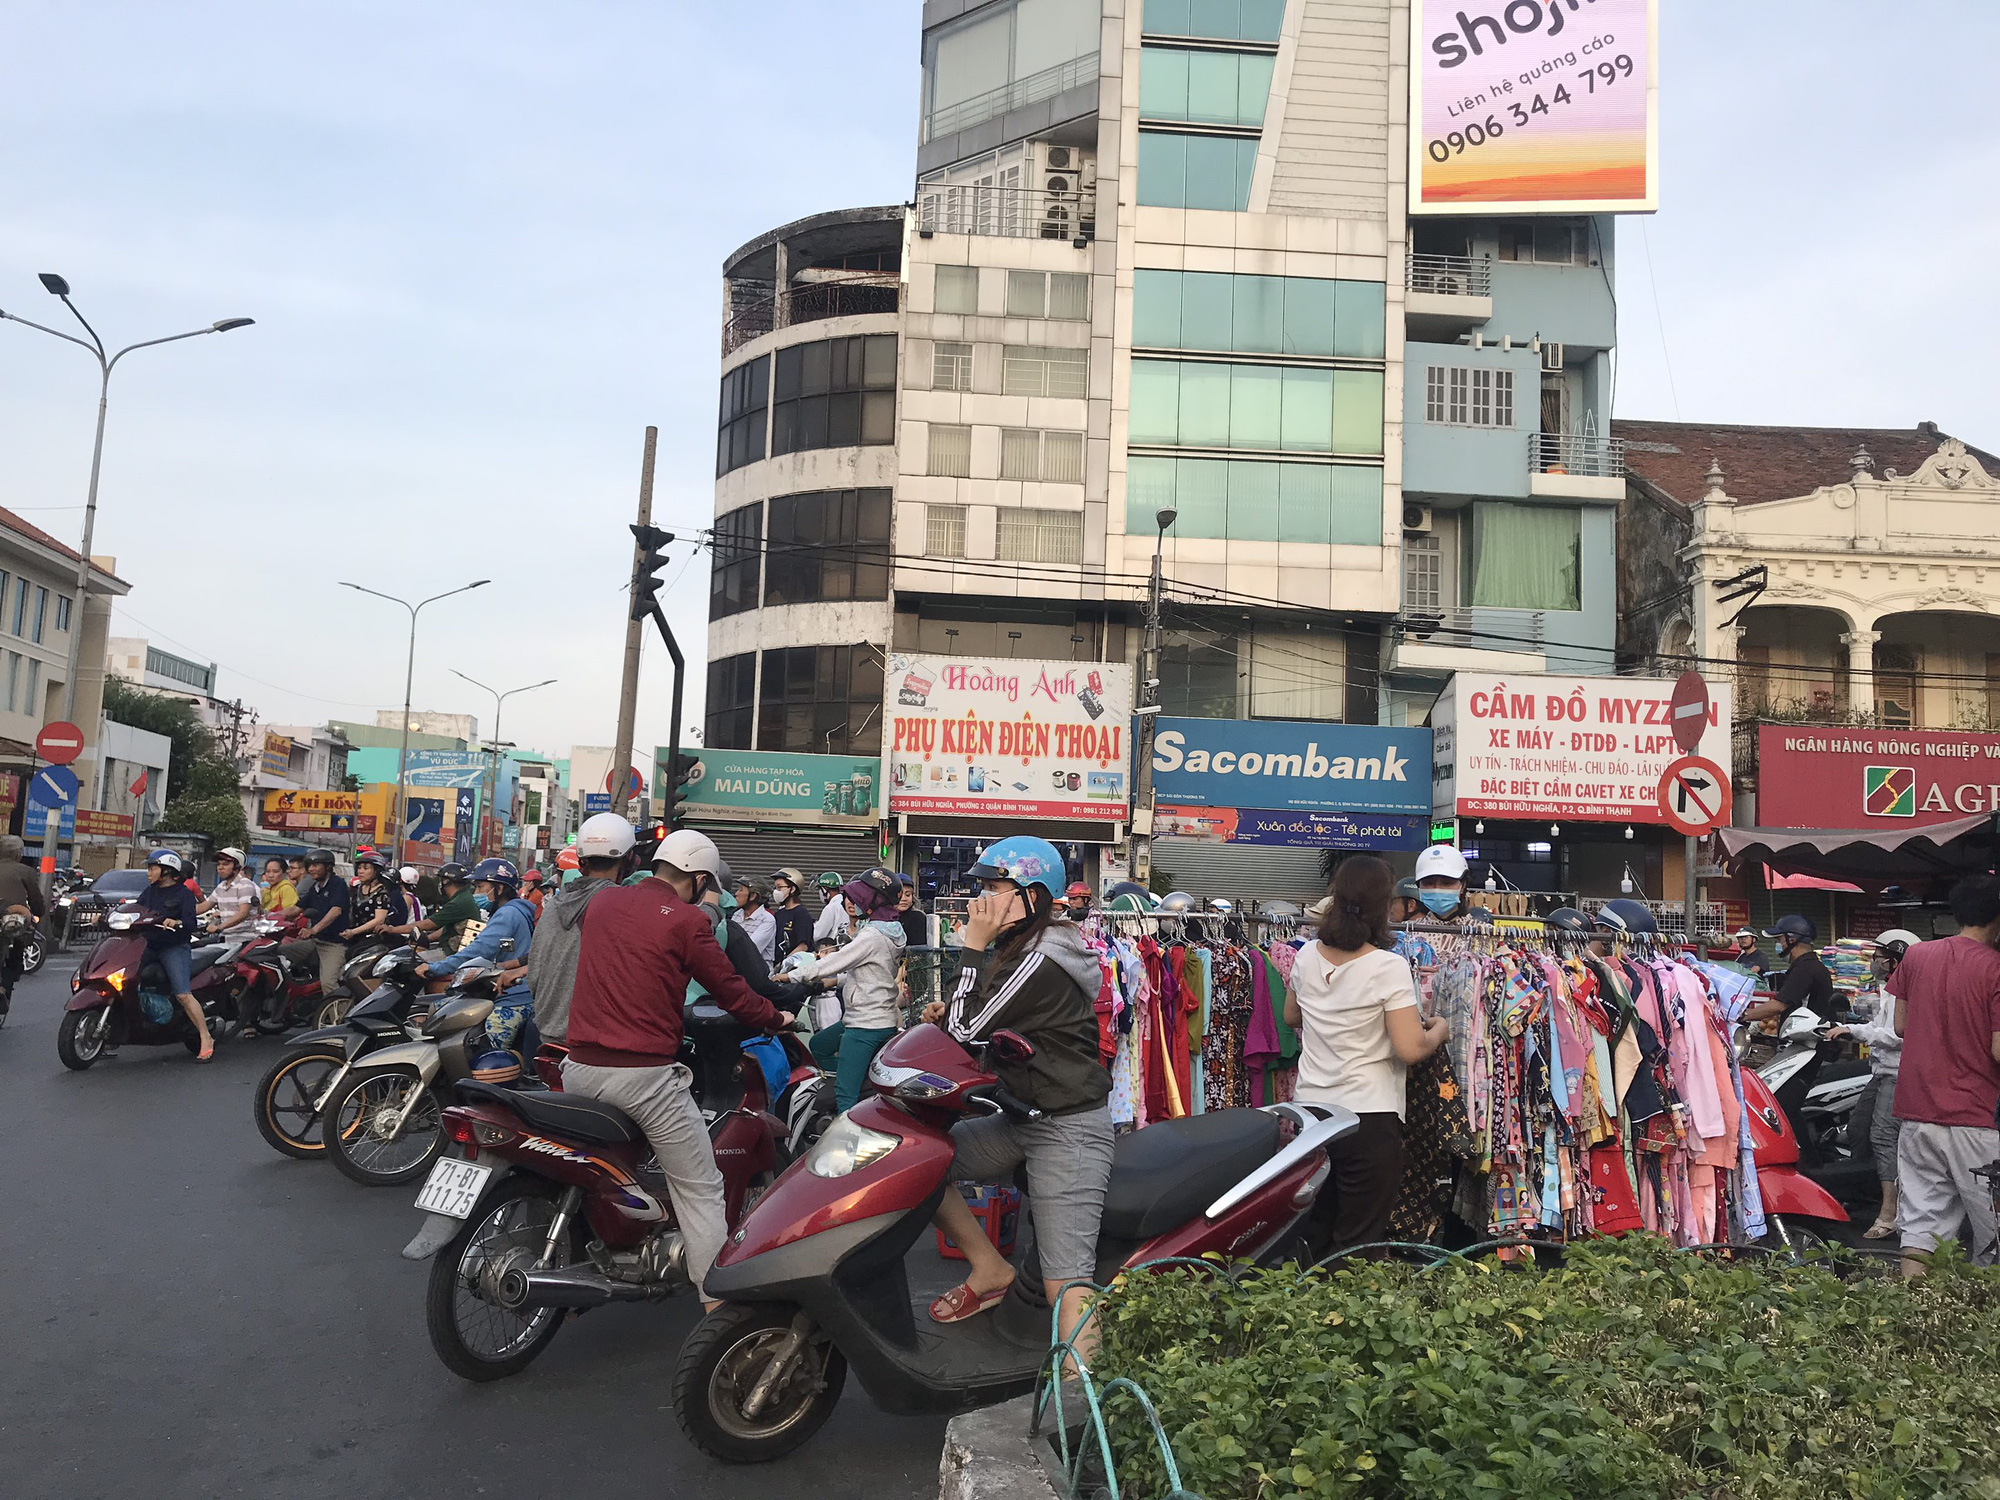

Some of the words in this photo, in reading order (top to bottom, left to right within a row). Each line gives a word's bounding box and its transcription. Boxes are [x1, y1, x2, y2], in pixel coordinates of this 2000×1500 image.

[1432, 0, 1597, 68] shoj
[1447, 93, 1487, 117] Liên
[1490, 77, 1513, 98] hệ
[1519, 51, 1578, 86] quảng
[1582, 34, 1615, 55] cáo
[1428, 114, 1504, 163] 0906
[1507, 83, 1571, 127] 344
[1578, 54, 1634, 94] 799
[941, 664, 1019, 702] Hoàng
[1031, 663, 1078, 704] Anh
[1469, 682, 1535, 720] CẦM
[1546, 685, 1587, 722] ĐỒ
[1599, 697, 1718, 727] MYZZN
[893, 717, 936, 762] PHỤ
[941, 708, 994, 765] KIỆN
[998, 711, 1050, 767] ĐIỆN
[1055, 723, 1122, 769] THOẠI
[1489, 728, 1510, 748] XE
[1517, 726, 1554, 750] MÁY
[1571, 732, 1617, 752] ĐTDĐ
[1785, 735, 1828, 752] NGÂN
[1831, 737, 1873, 754] HÀNG
[1878, 739, 1920, 756] NÔNG
[1925, 741, 1980, 761] NGHIỆP
[1153, 730, 1410, 782] Sacombank
[1470, 756, 1482, 769] UY
[1485, 753, 1501, 770] TÍN
[1510, 754, 1541, 772] TRÁCH
[1544, 756, 1577, 776] NHIỆM
[1585, 761, 1605, 775] CHU
[1608, 758, 1629, 776] ĐÁO
[1637, 760, 1651, 776] LÃI
[724, 765, 742, 774] CỬA
[743, 765, 768, 775] HÀNG
[769, 768, 785, 777] TẠP
[786, 767, 804, 776] HÓA
[715, 778, 750, 793] MAI
[755, 778, 811, 797] DŨNG
[1481, 777, 1506, 798] ĐẶC
[1511, 777, 1539, 798] BIỆT
[1544, 776, 1571, 797] CẦM
[1575, 783, 1614, 799] CAVET
[1620, 785, 1635, 799] XE
[456, 806, 472, 816] PNJ
[922, 800, 934, 808] HỮU
[956, 801, 979, 809] PHƯỜNG
[986, 802, 1001, 811] QUẬN
[1003, 802, 1016, 811] BÌNH
[1018, 804, 1038, 812] THẠNH
[1468, 801, 1482, 809] ĐC:
[1483, 801, 1497, 810] 380
[1499, 801, 1512, 811] BÙI
[1514, 802, 1531, 812] HỮU
[1533, 802, 1560, 814] NGHĨA,
[1606, 806, 1632, 817] THẠNH
[1256, 820, 1286, 833] Xuân
[1288, 821, 1312, 832] đắc
[1314, 823, 1331, 835] lộc
[1342, 823, 1358, 835] Tết
[1360, 825, 1386, 837] phát
[1388, 826, 1402, 837] tài
[1309, 814, 1349, 823] Sacombank
[518, 1136, 573, 1156] Wave
[422, 1183, 475, 1214] 111.75
